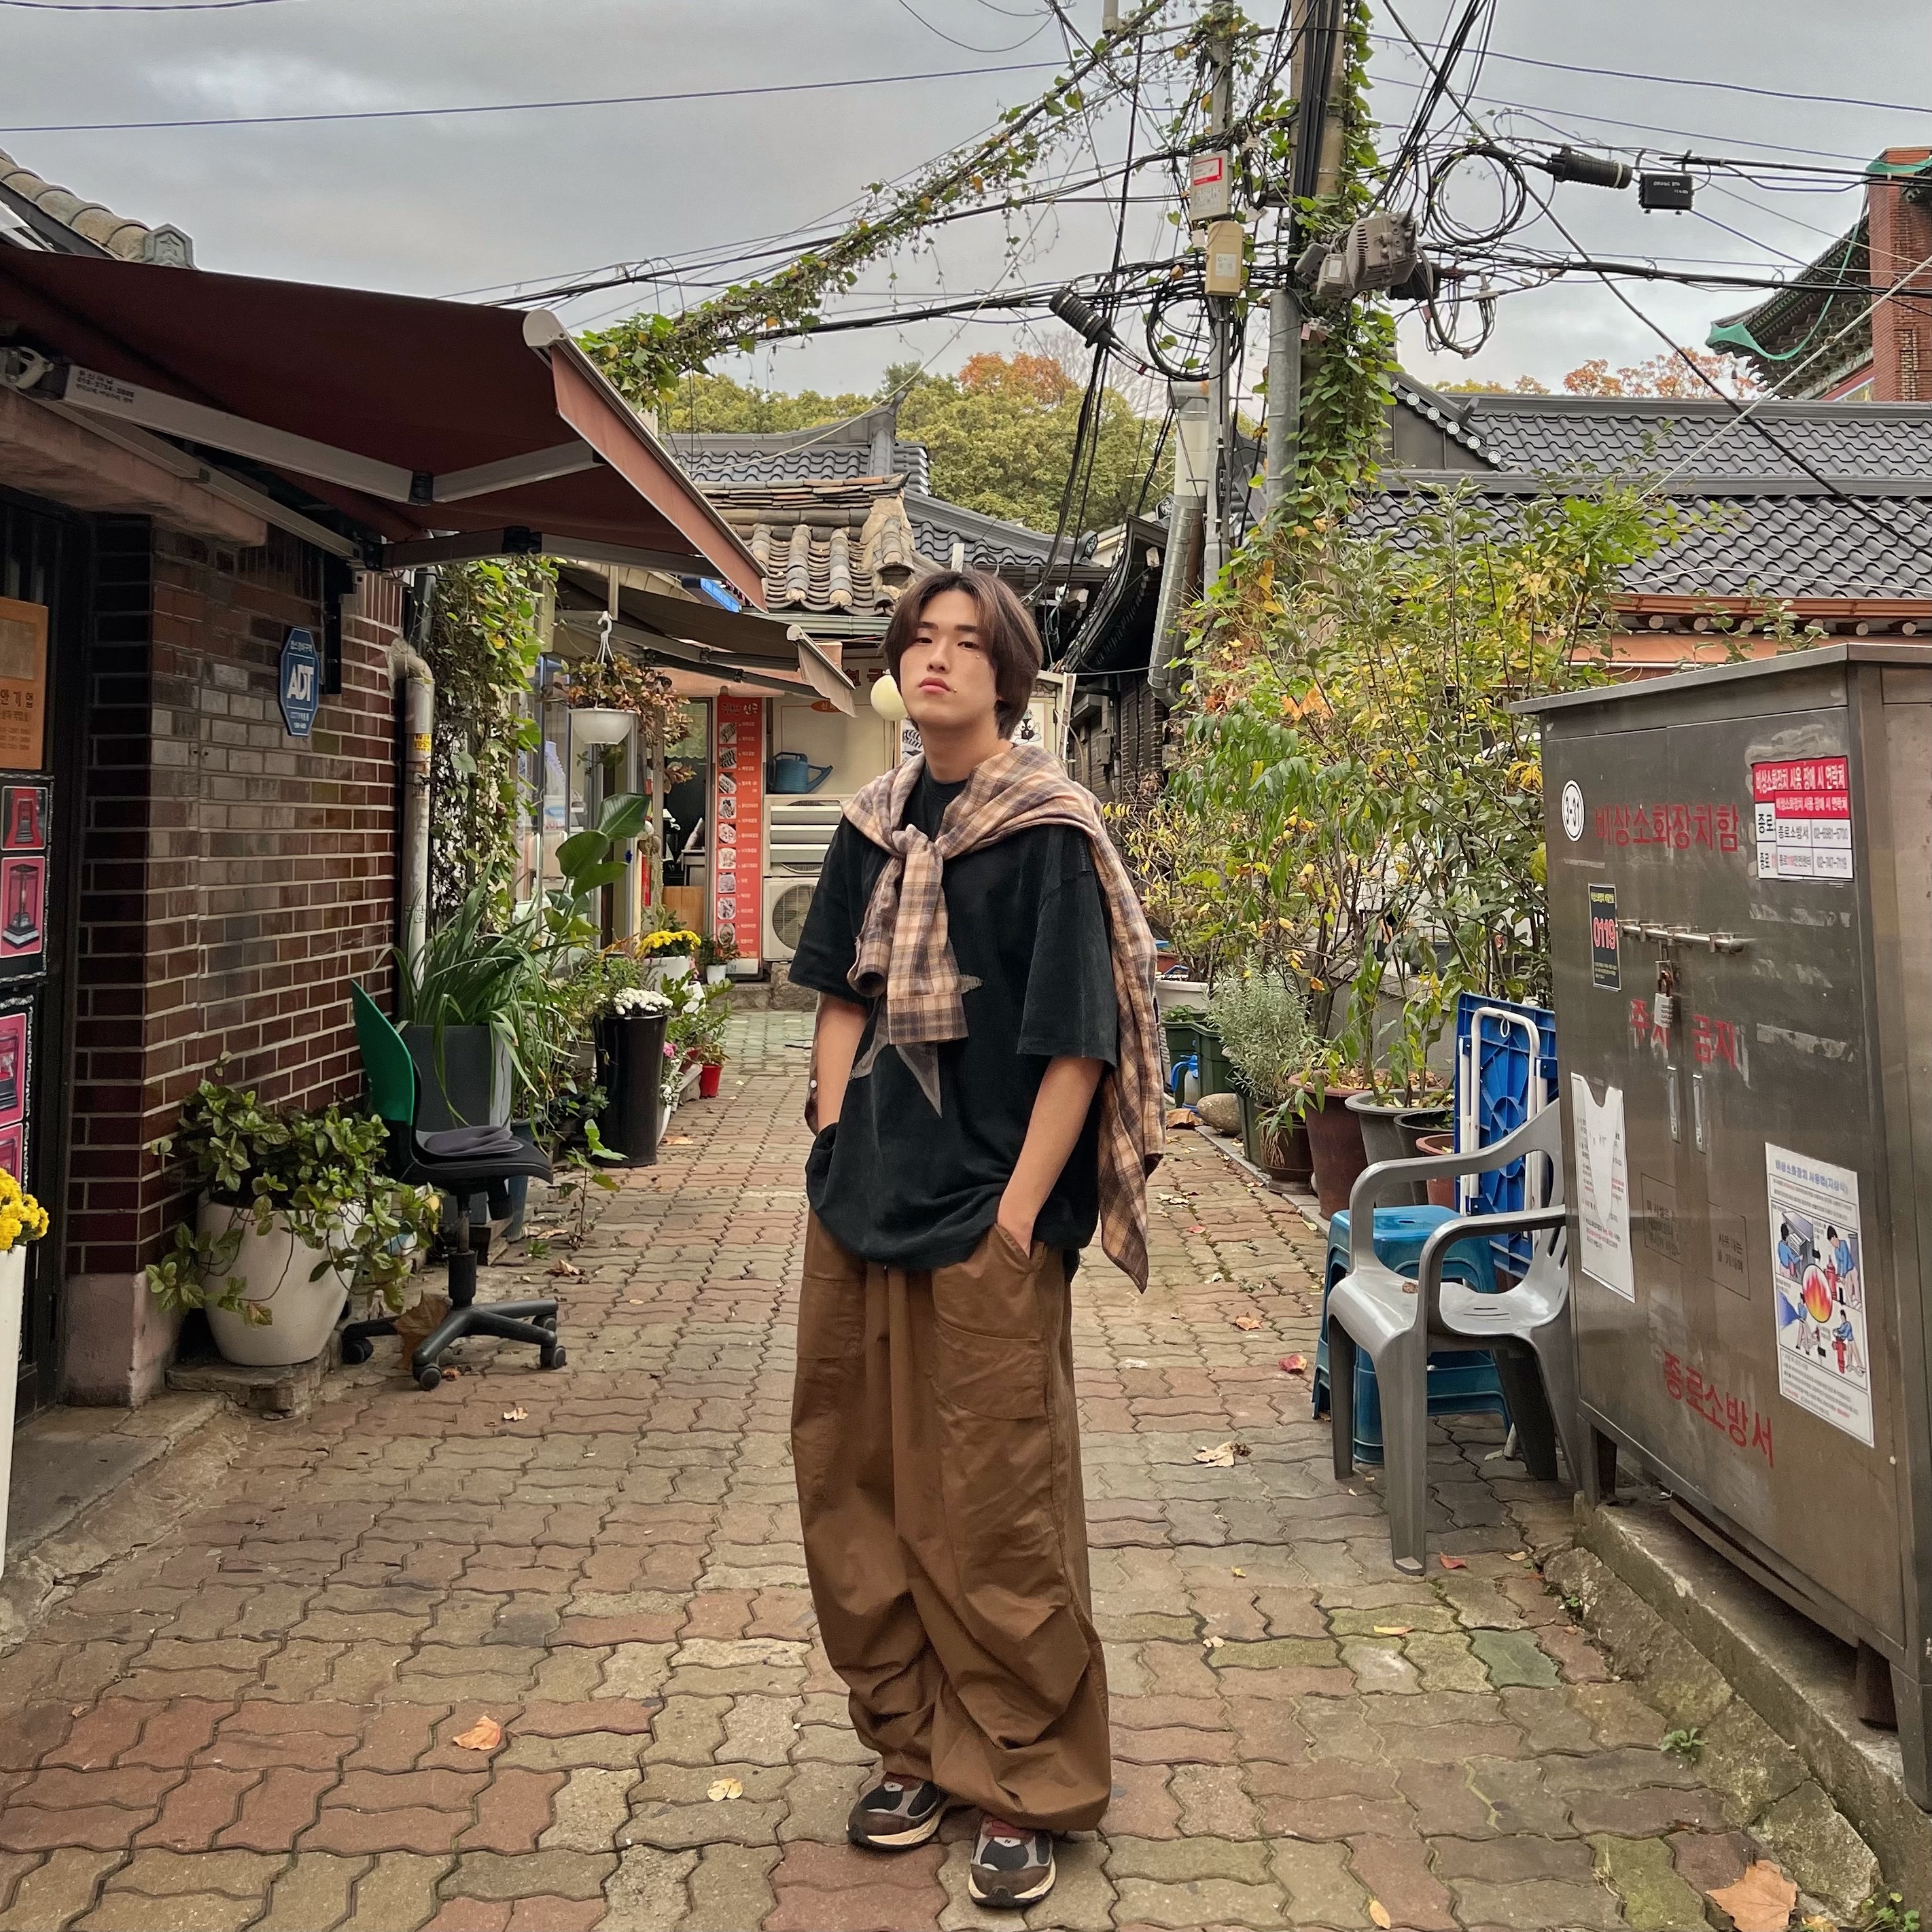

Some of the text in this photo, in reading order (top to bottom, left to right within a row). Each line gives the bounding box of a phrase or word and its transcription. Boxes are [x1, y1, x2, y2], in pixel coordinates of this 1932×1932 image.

[286, 664, 314, 702] ADT
[1817, 765, 1825, 789] 시
[1565, 795, 1580, 828] 3-31
[1594, 803, 1740, 853] 비상소화장치함
[1778, 826, 1809, 839] 종로소방서
[1592, 916, 1616, 950] 0119
[1691, 1013, 1736, 1072] 금지
[1664, 1350, 1774, 1469] 종로소방서
